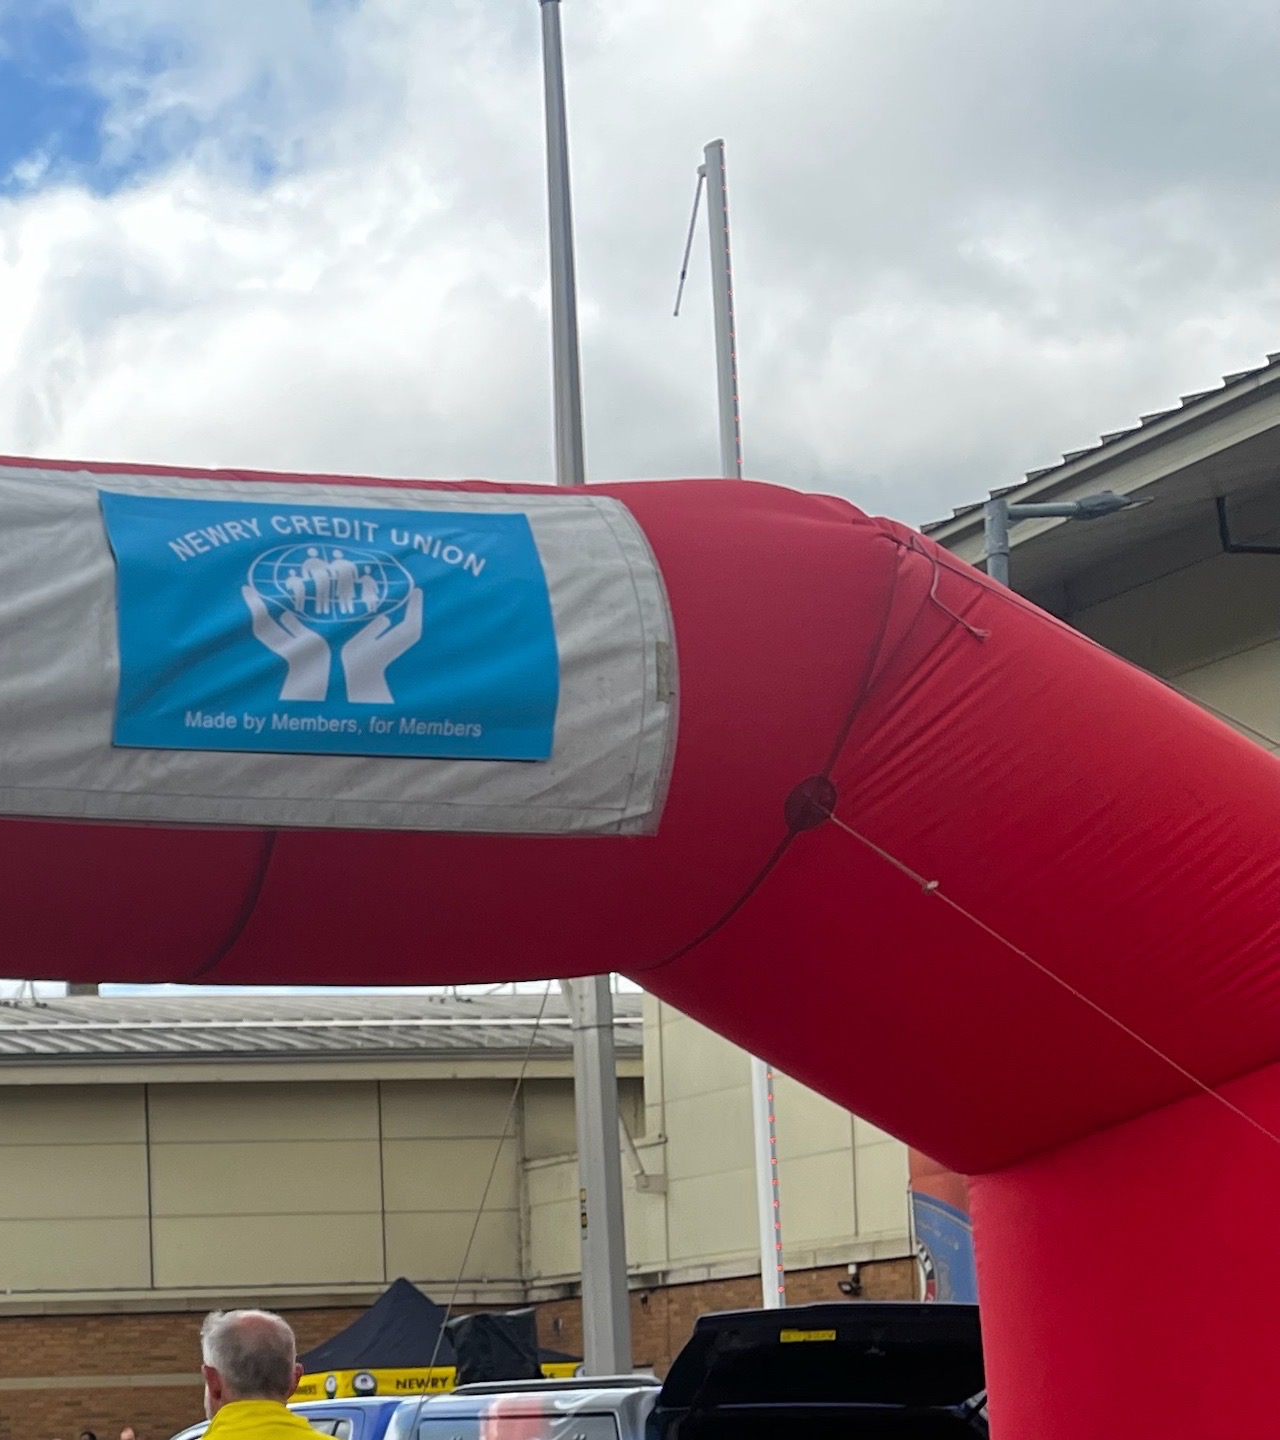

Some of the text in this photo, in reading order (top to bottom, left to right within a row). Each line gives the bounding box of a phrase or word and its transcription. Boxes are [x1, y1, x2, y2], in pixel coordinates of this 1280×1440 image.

[168, 515, 487, 577] NEWRY CREDIT UNION
[184, 710, 482, 738] Made by Members, for Members
[396, 1377, 449, 1390] NEWRY
